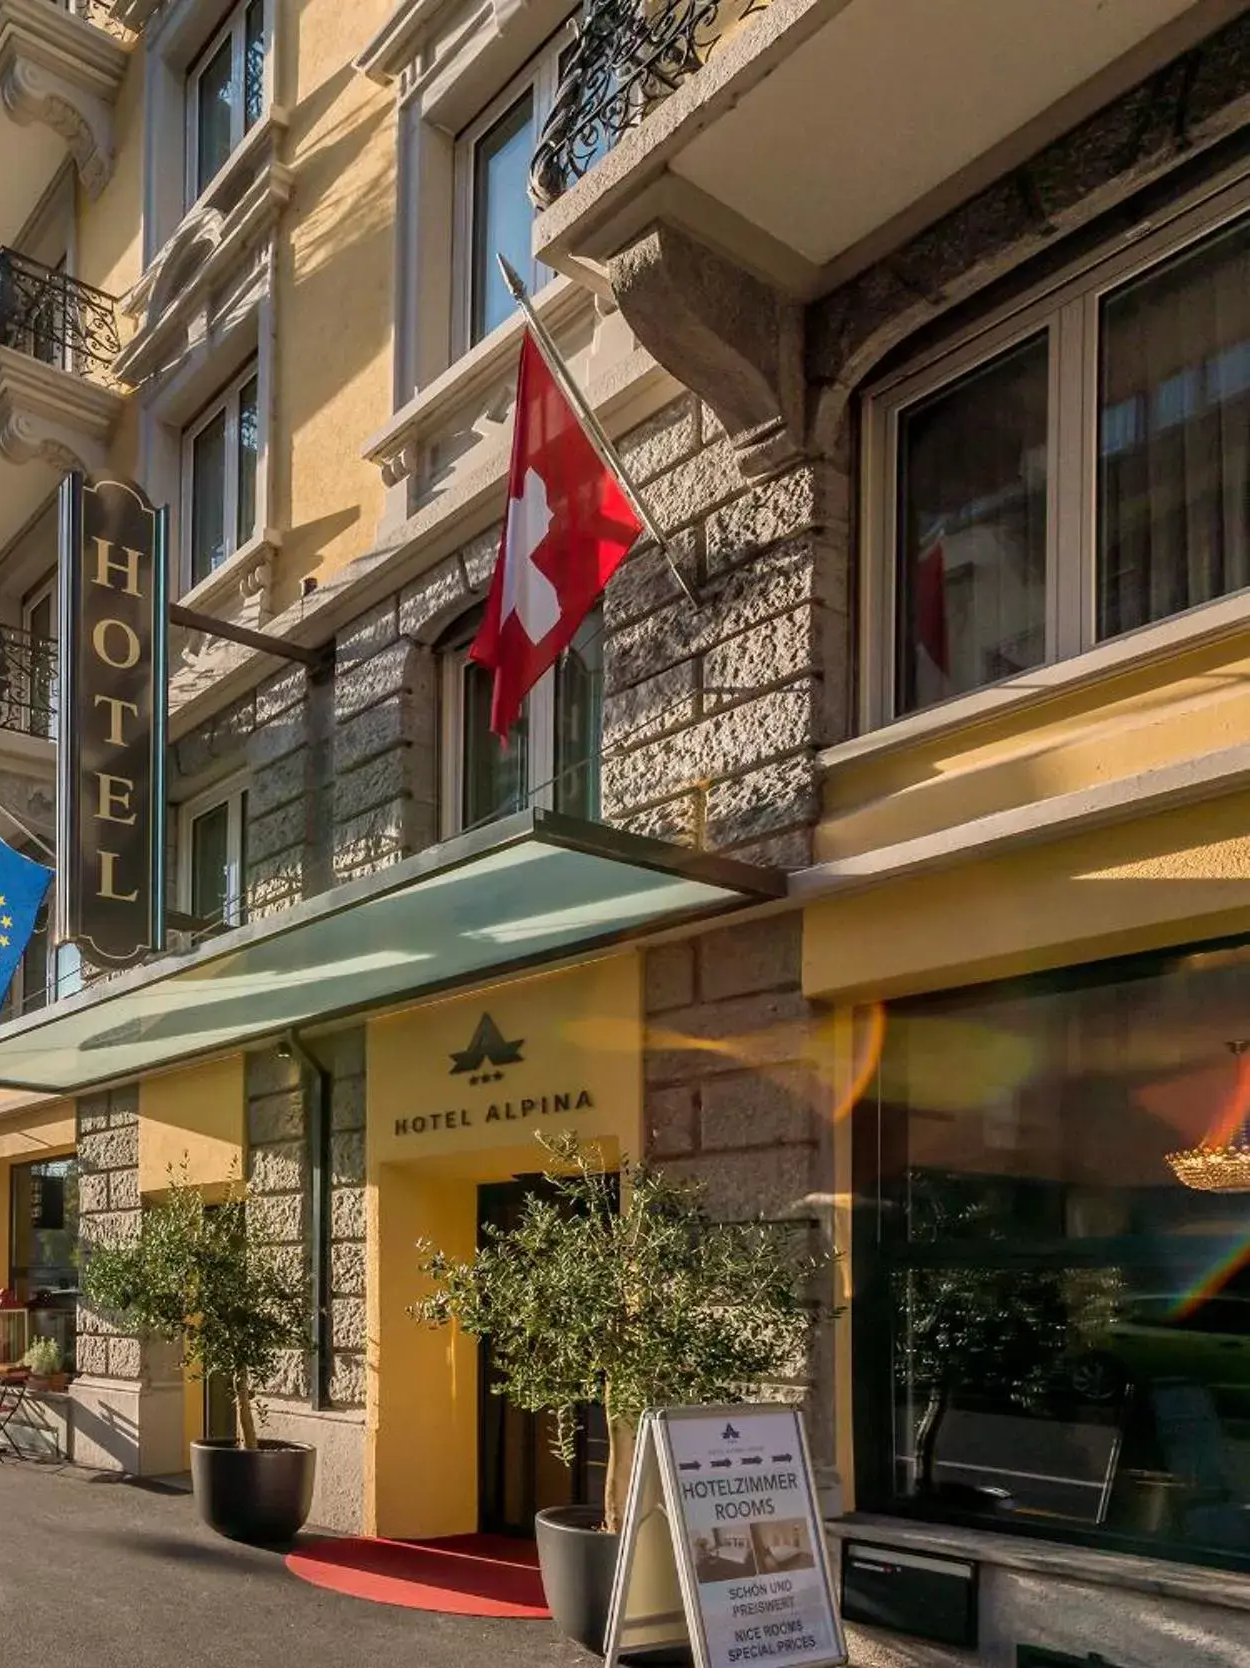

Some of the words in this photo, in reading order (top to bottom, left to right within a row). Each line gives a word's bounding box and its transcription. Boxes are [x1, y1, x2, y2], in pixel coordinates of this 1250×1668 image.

[90, 535, 143, 902] HOTEL
[394, 1109, 472, 1136] HOTEL
[485, 1090, 593, 1123] ALPINA
[682, 1473, 798, 1500] HOTELZIMMER
[715, 1498, 775, 1520] ROOMS
[734, 1627, 762, 1642] NICE
[763, 1620, 803, 1637] ROOMS
[728, 1645, 775, 1662] SPECIAL
[777, 1635, 816, 1653] PRICES
